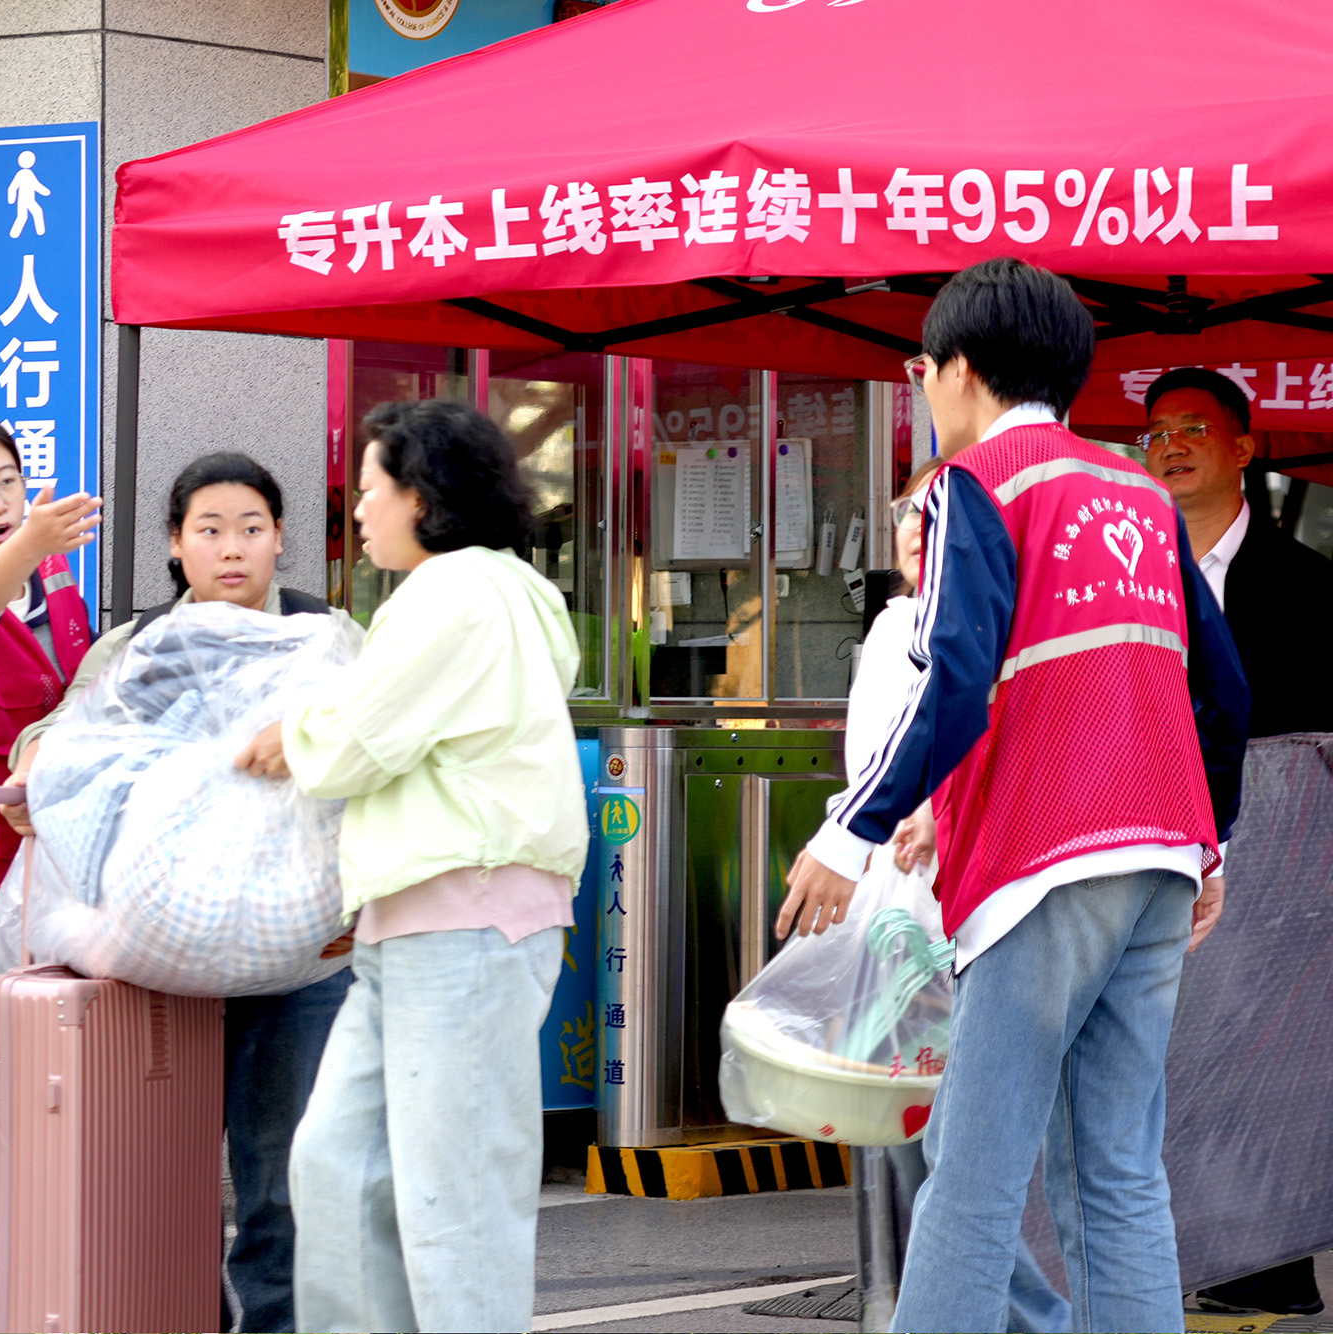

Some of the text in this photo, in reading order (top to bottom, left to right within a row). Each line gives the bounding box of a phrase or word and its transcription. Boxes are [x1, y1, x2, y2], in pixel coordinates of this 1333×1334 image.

[277, 163, 1279, 275] 专升本上线率连续十年95%以上
[604, 890, 628, 1086] 人行通道
